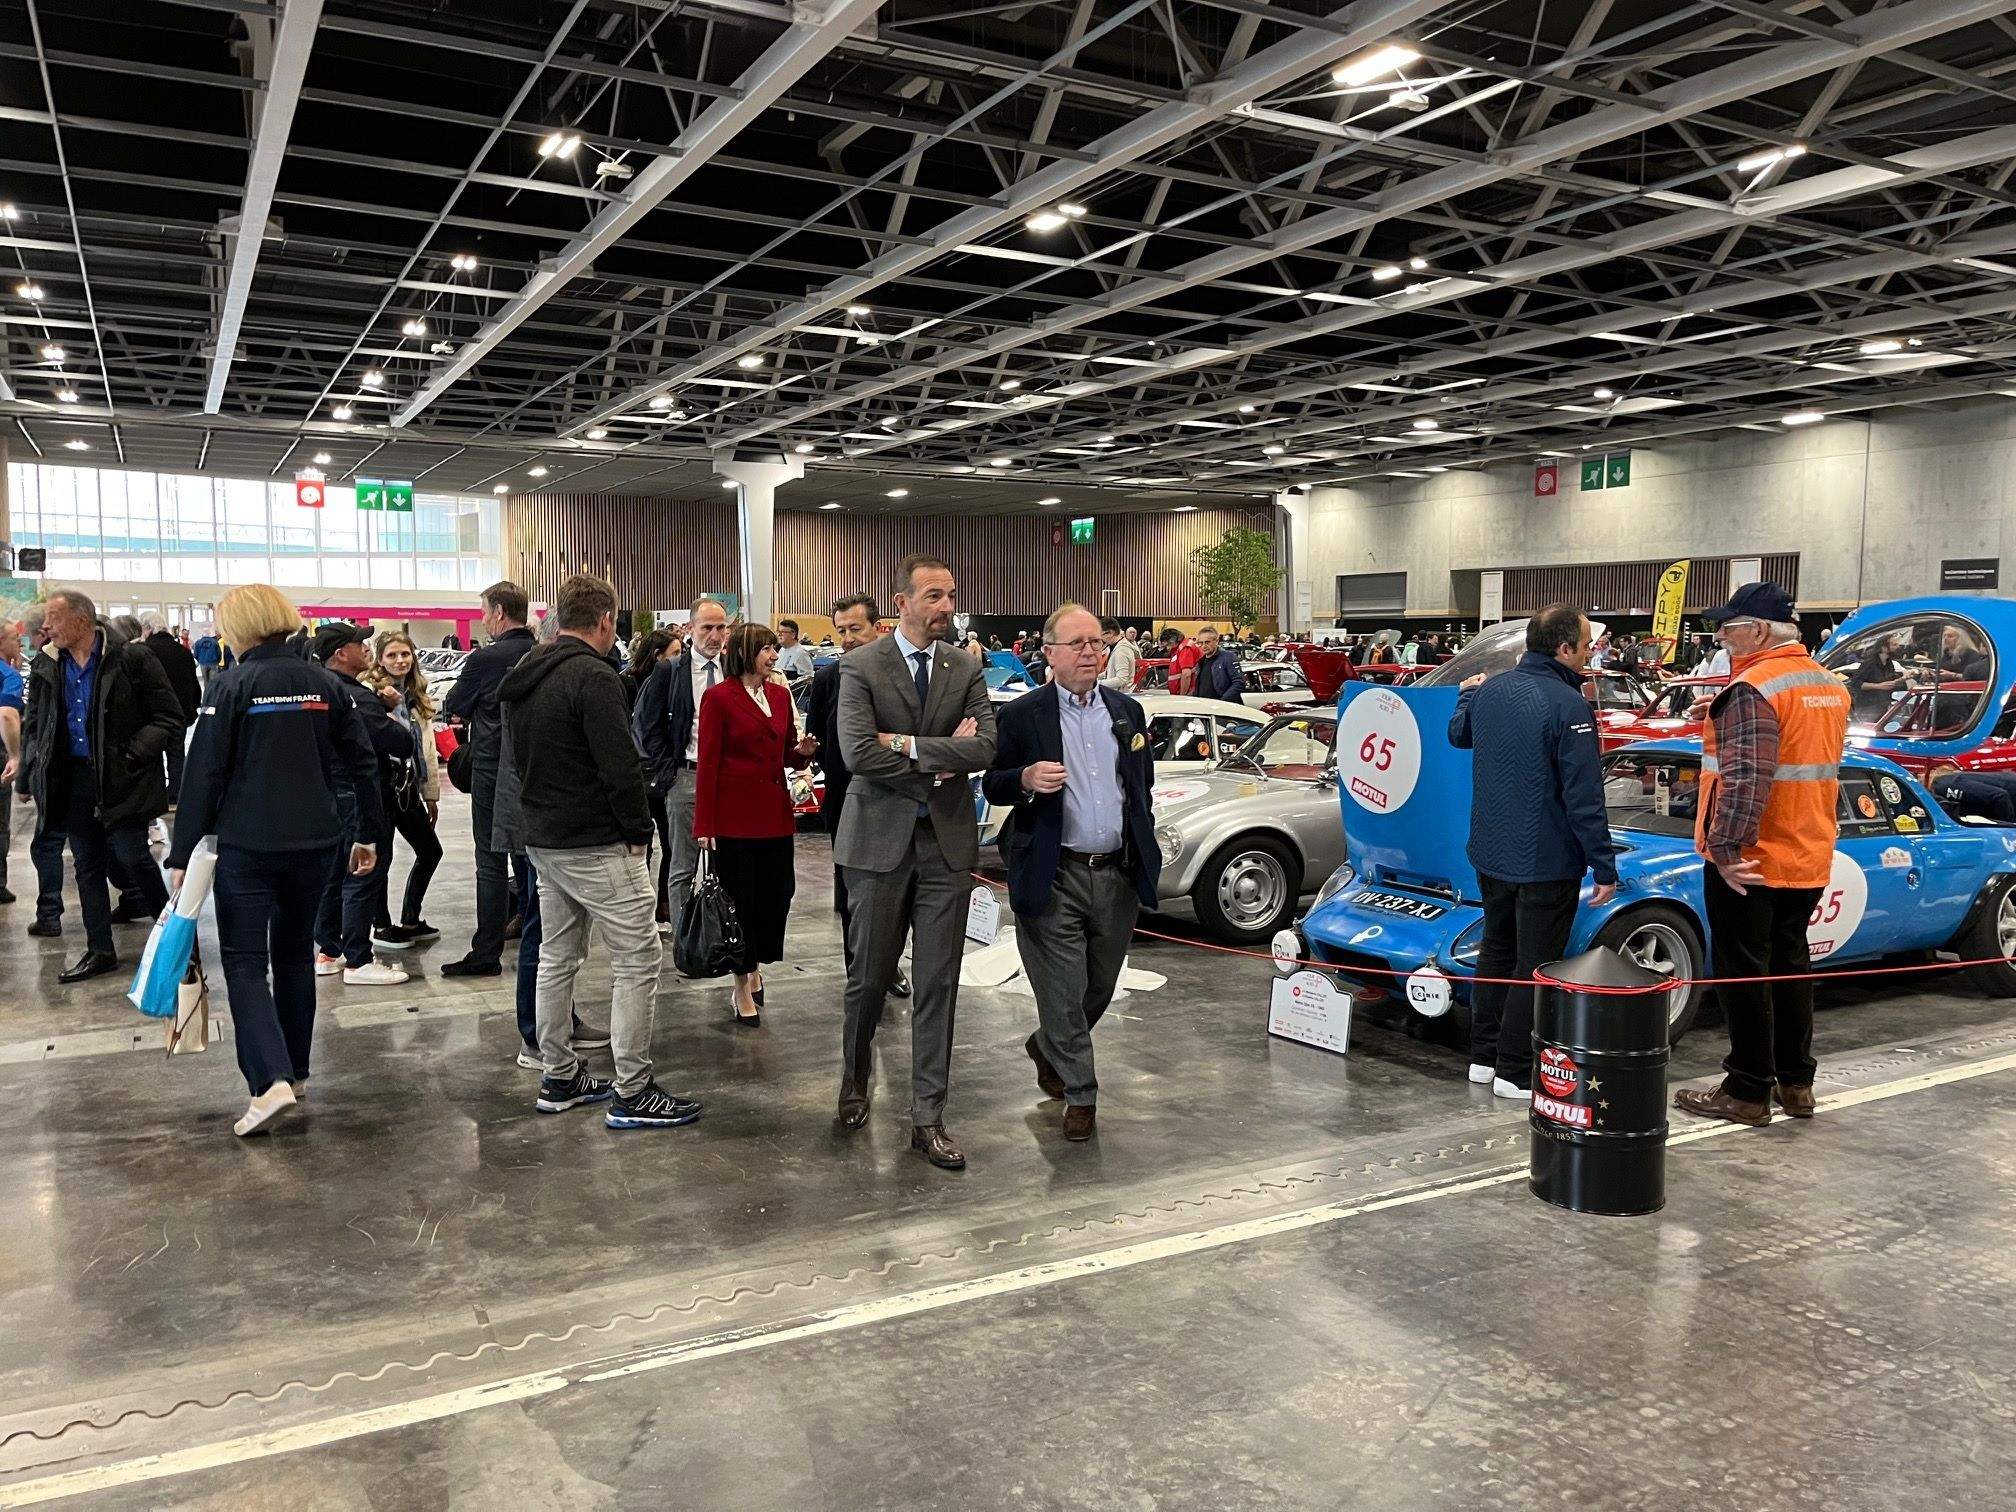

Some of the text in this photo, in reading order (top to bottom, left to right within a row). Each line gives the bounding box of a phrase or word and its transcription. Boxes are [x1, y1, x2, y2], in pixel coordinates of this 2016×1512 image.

[252, 696, 275, 704] TEAM
[293, 694, 321, 702] FRANCE
[1360, 732, 1396, 771] 65
[1353, 779, 1386, 804] MOTUL
[1352, 892, 1442, 919] DV-237-XJ
[1540, 1062, 1577, 1082] MOTUL
[1534, 1094, 1588, 1124] MOTUL
